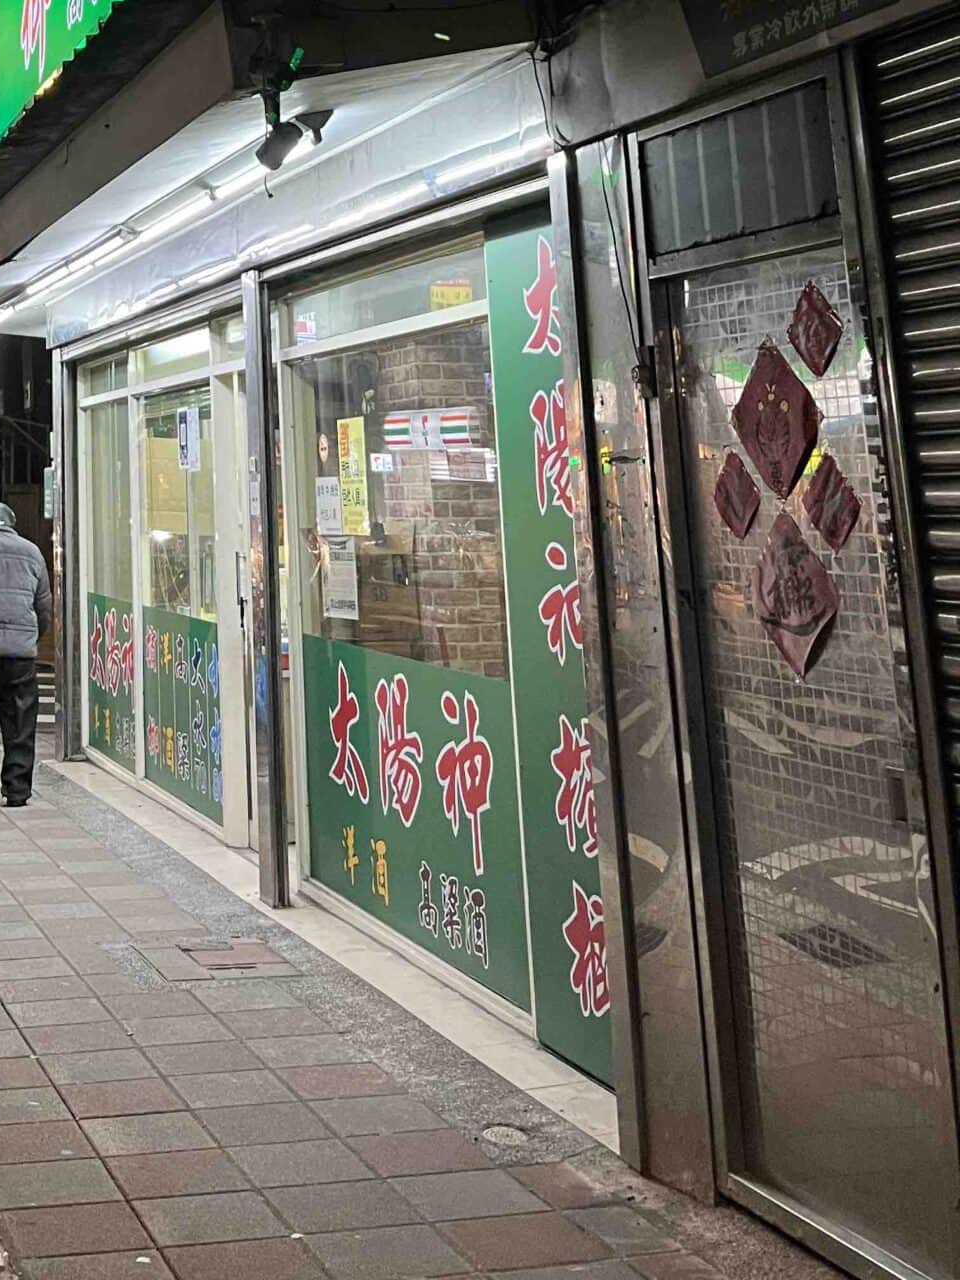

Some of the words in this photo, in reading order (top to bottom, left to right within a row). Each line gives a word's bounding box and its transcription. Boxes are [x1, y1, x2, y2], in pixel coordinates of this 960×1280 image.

[329, 661, 493, 876] 太陽神
[342, 825, 389, 906] 洋酒
